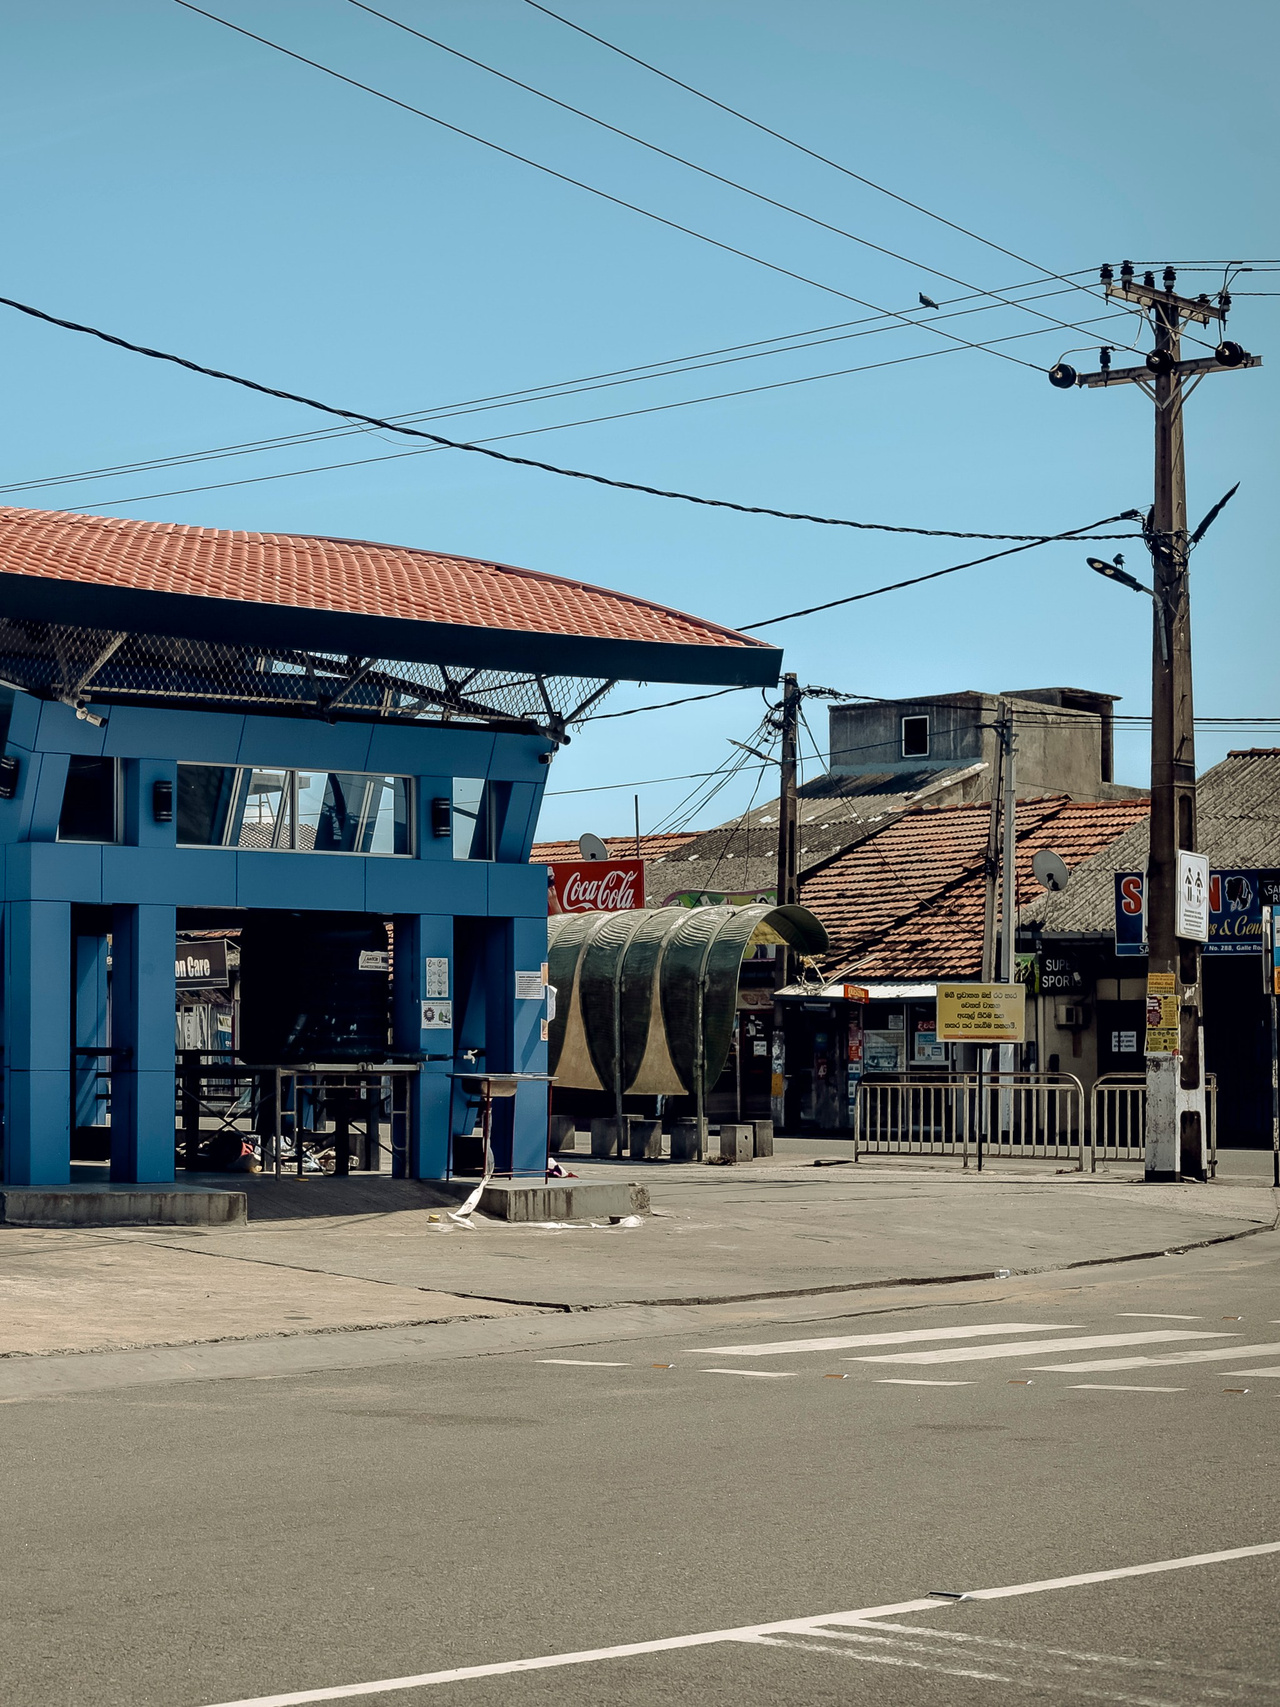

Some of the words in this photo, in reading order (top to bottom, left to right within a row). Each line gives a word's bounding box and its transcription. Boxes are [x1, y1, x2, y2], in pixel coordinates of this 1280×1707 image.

[563, 871, 639, 910] Coca-Cola
[1220, 919, 1232, 935] &
[187, 956, 210, 977] Care
